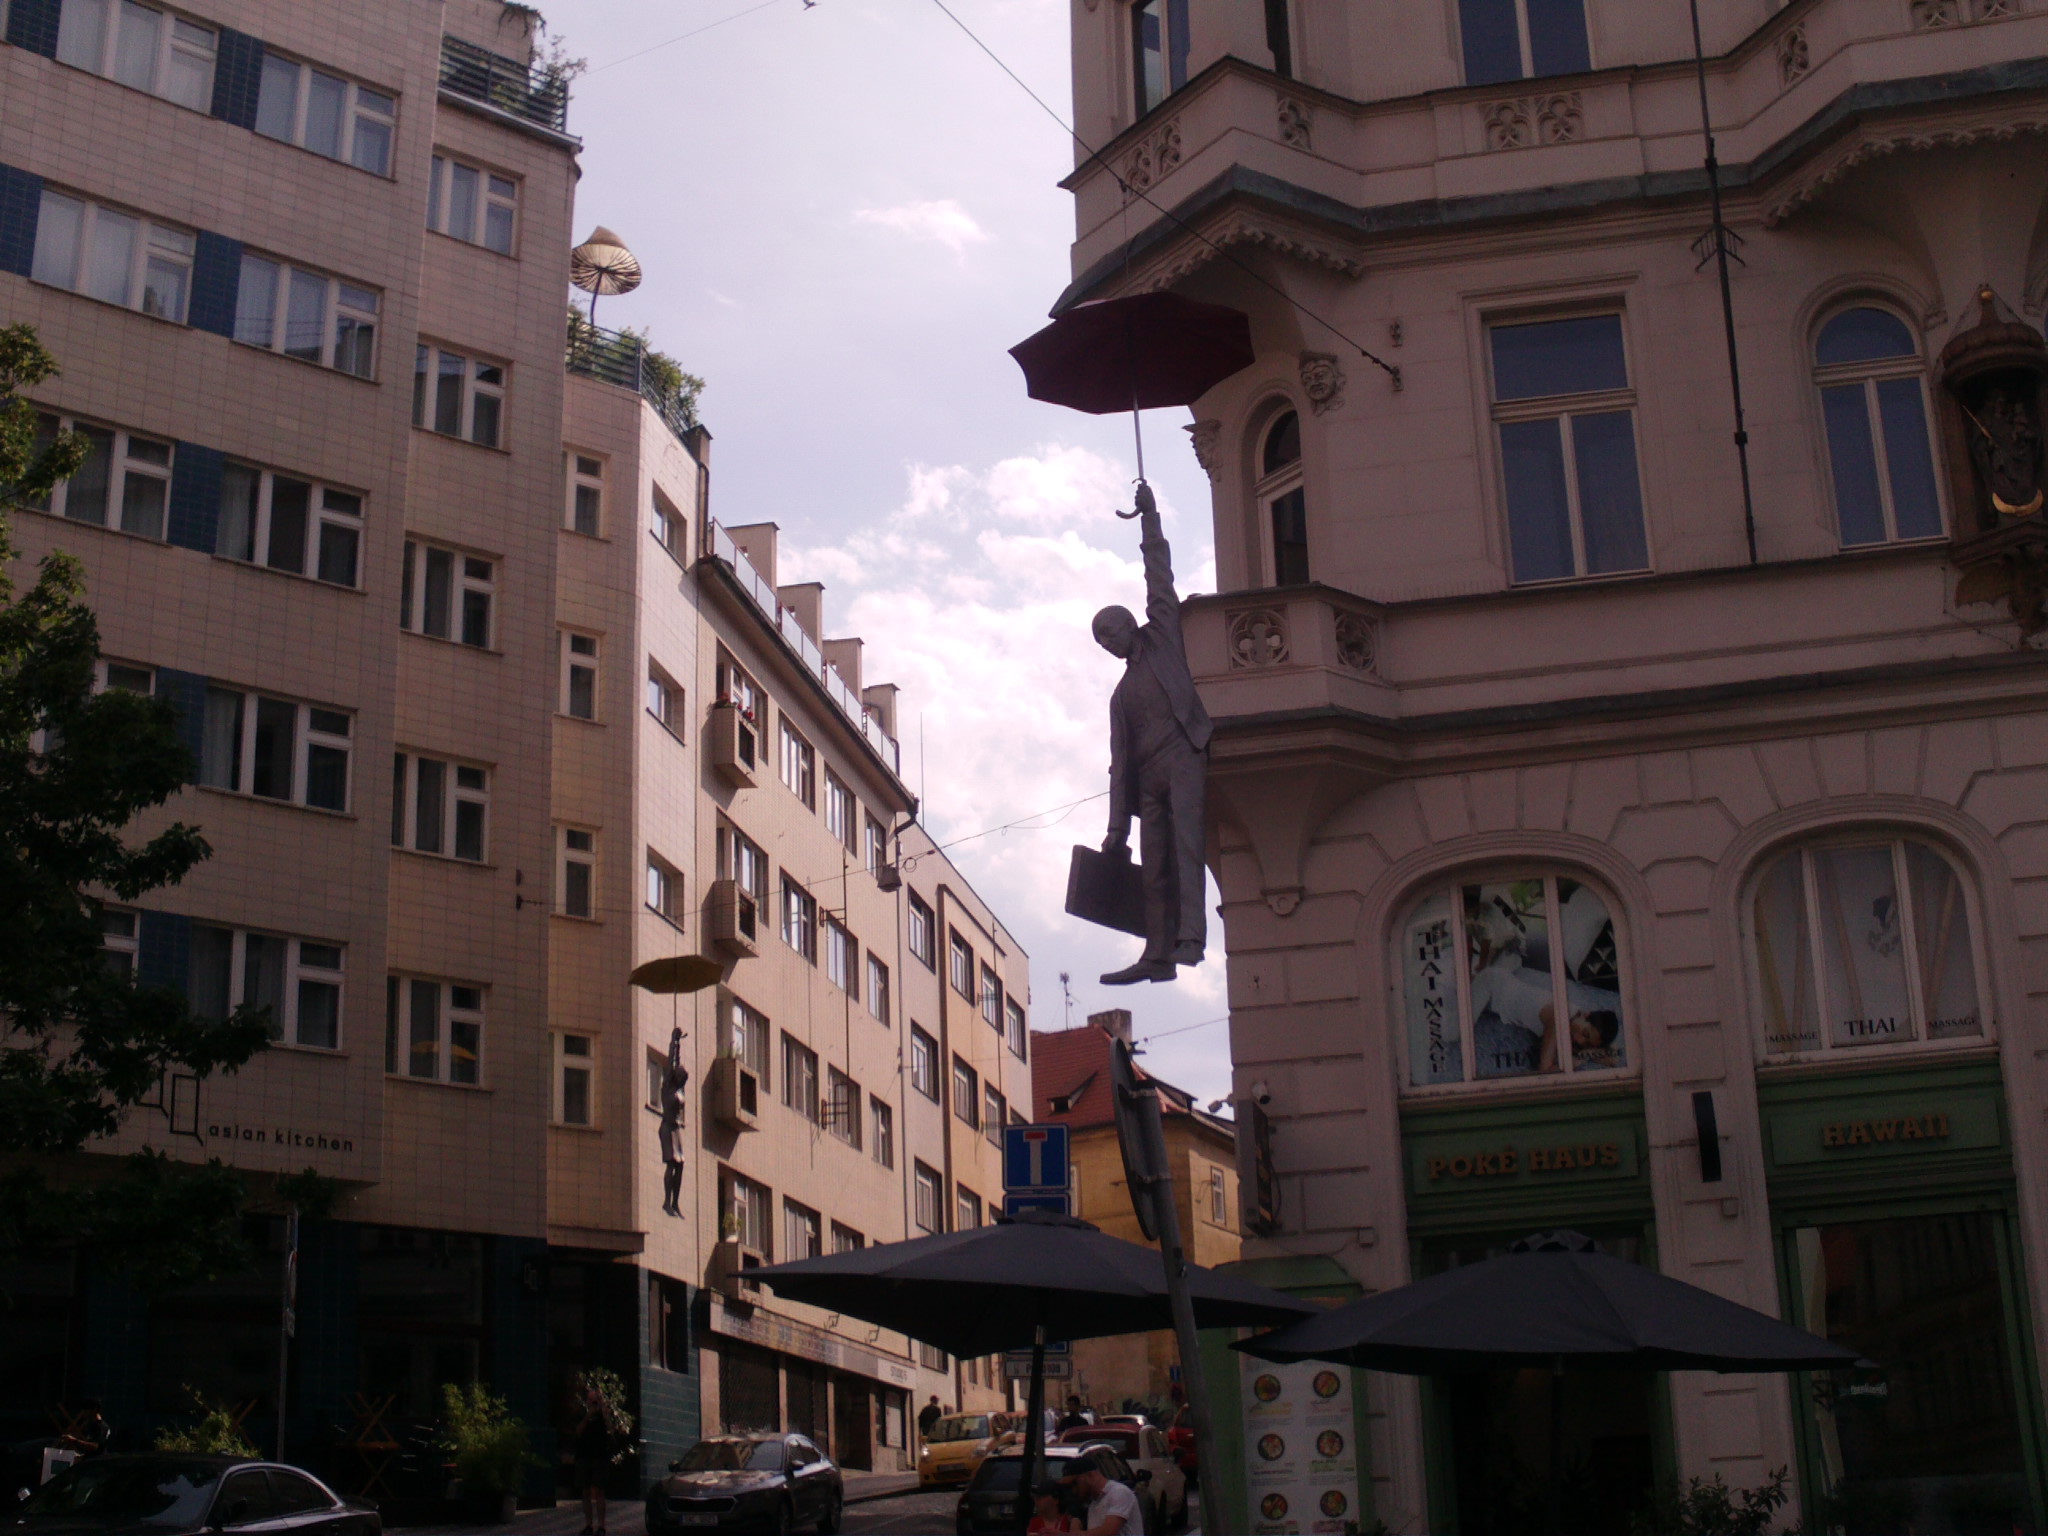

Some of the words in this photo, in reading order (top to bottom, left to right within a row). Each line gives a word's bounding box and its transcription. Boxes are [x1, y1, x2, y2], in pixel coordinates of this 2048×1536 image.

[1844, 1017, 1896, 1036] THAI
[208, 1123, 265, 1142] asian
[275, 1129, 353, 1151] kitchen
[1824, 1114, 1949, 1146] HAWAII
[1429, 1144, 1518, 1179] POKÉ
[1529, 1143, 1619, 1171] HAUS
